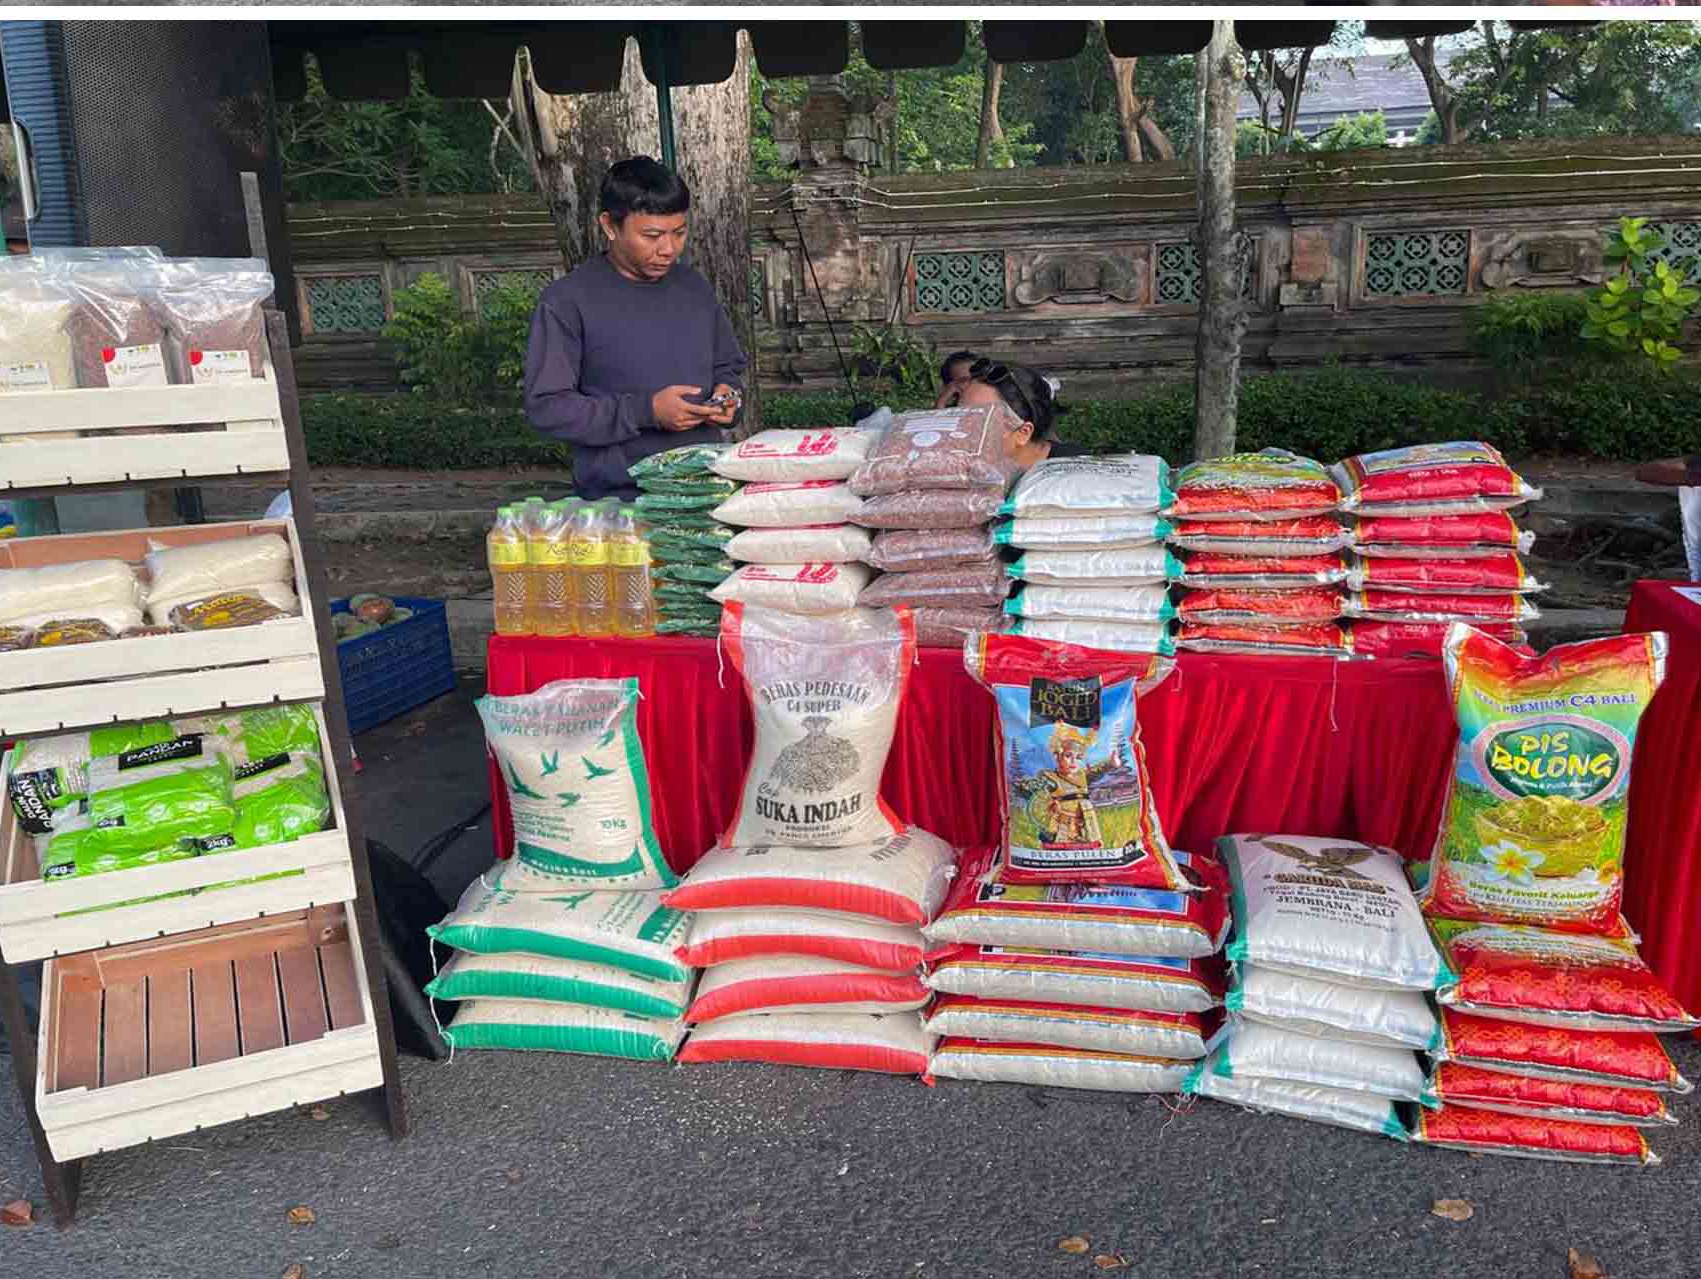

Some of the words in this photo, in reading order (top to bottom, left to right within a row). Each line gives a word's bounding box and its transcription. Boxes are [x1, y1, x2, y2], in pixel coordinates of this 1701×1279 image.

[761, 682, 801, 704] BERAS
[804, 680, 871, 705] PEDESAAN
[1503, 699, 1566, 714] PREMIUM
[1570, 694, 1596, 708] C4
[1601, 693, 1637, 705] BALI
[804, 698, 841, 713] SUPER
[125, 738, 195, 763] PANDAN
[1520, 730, 1571, 755] PIS
[1492, 740, 1613, 780] BOLONG
[755, 795, 800, 824] SUKA
[803, 792, 862, 824] INDAH
[1276, 895, 1352, 912] JEMBRANA
[1364, 905, 1396, 918] BALI
